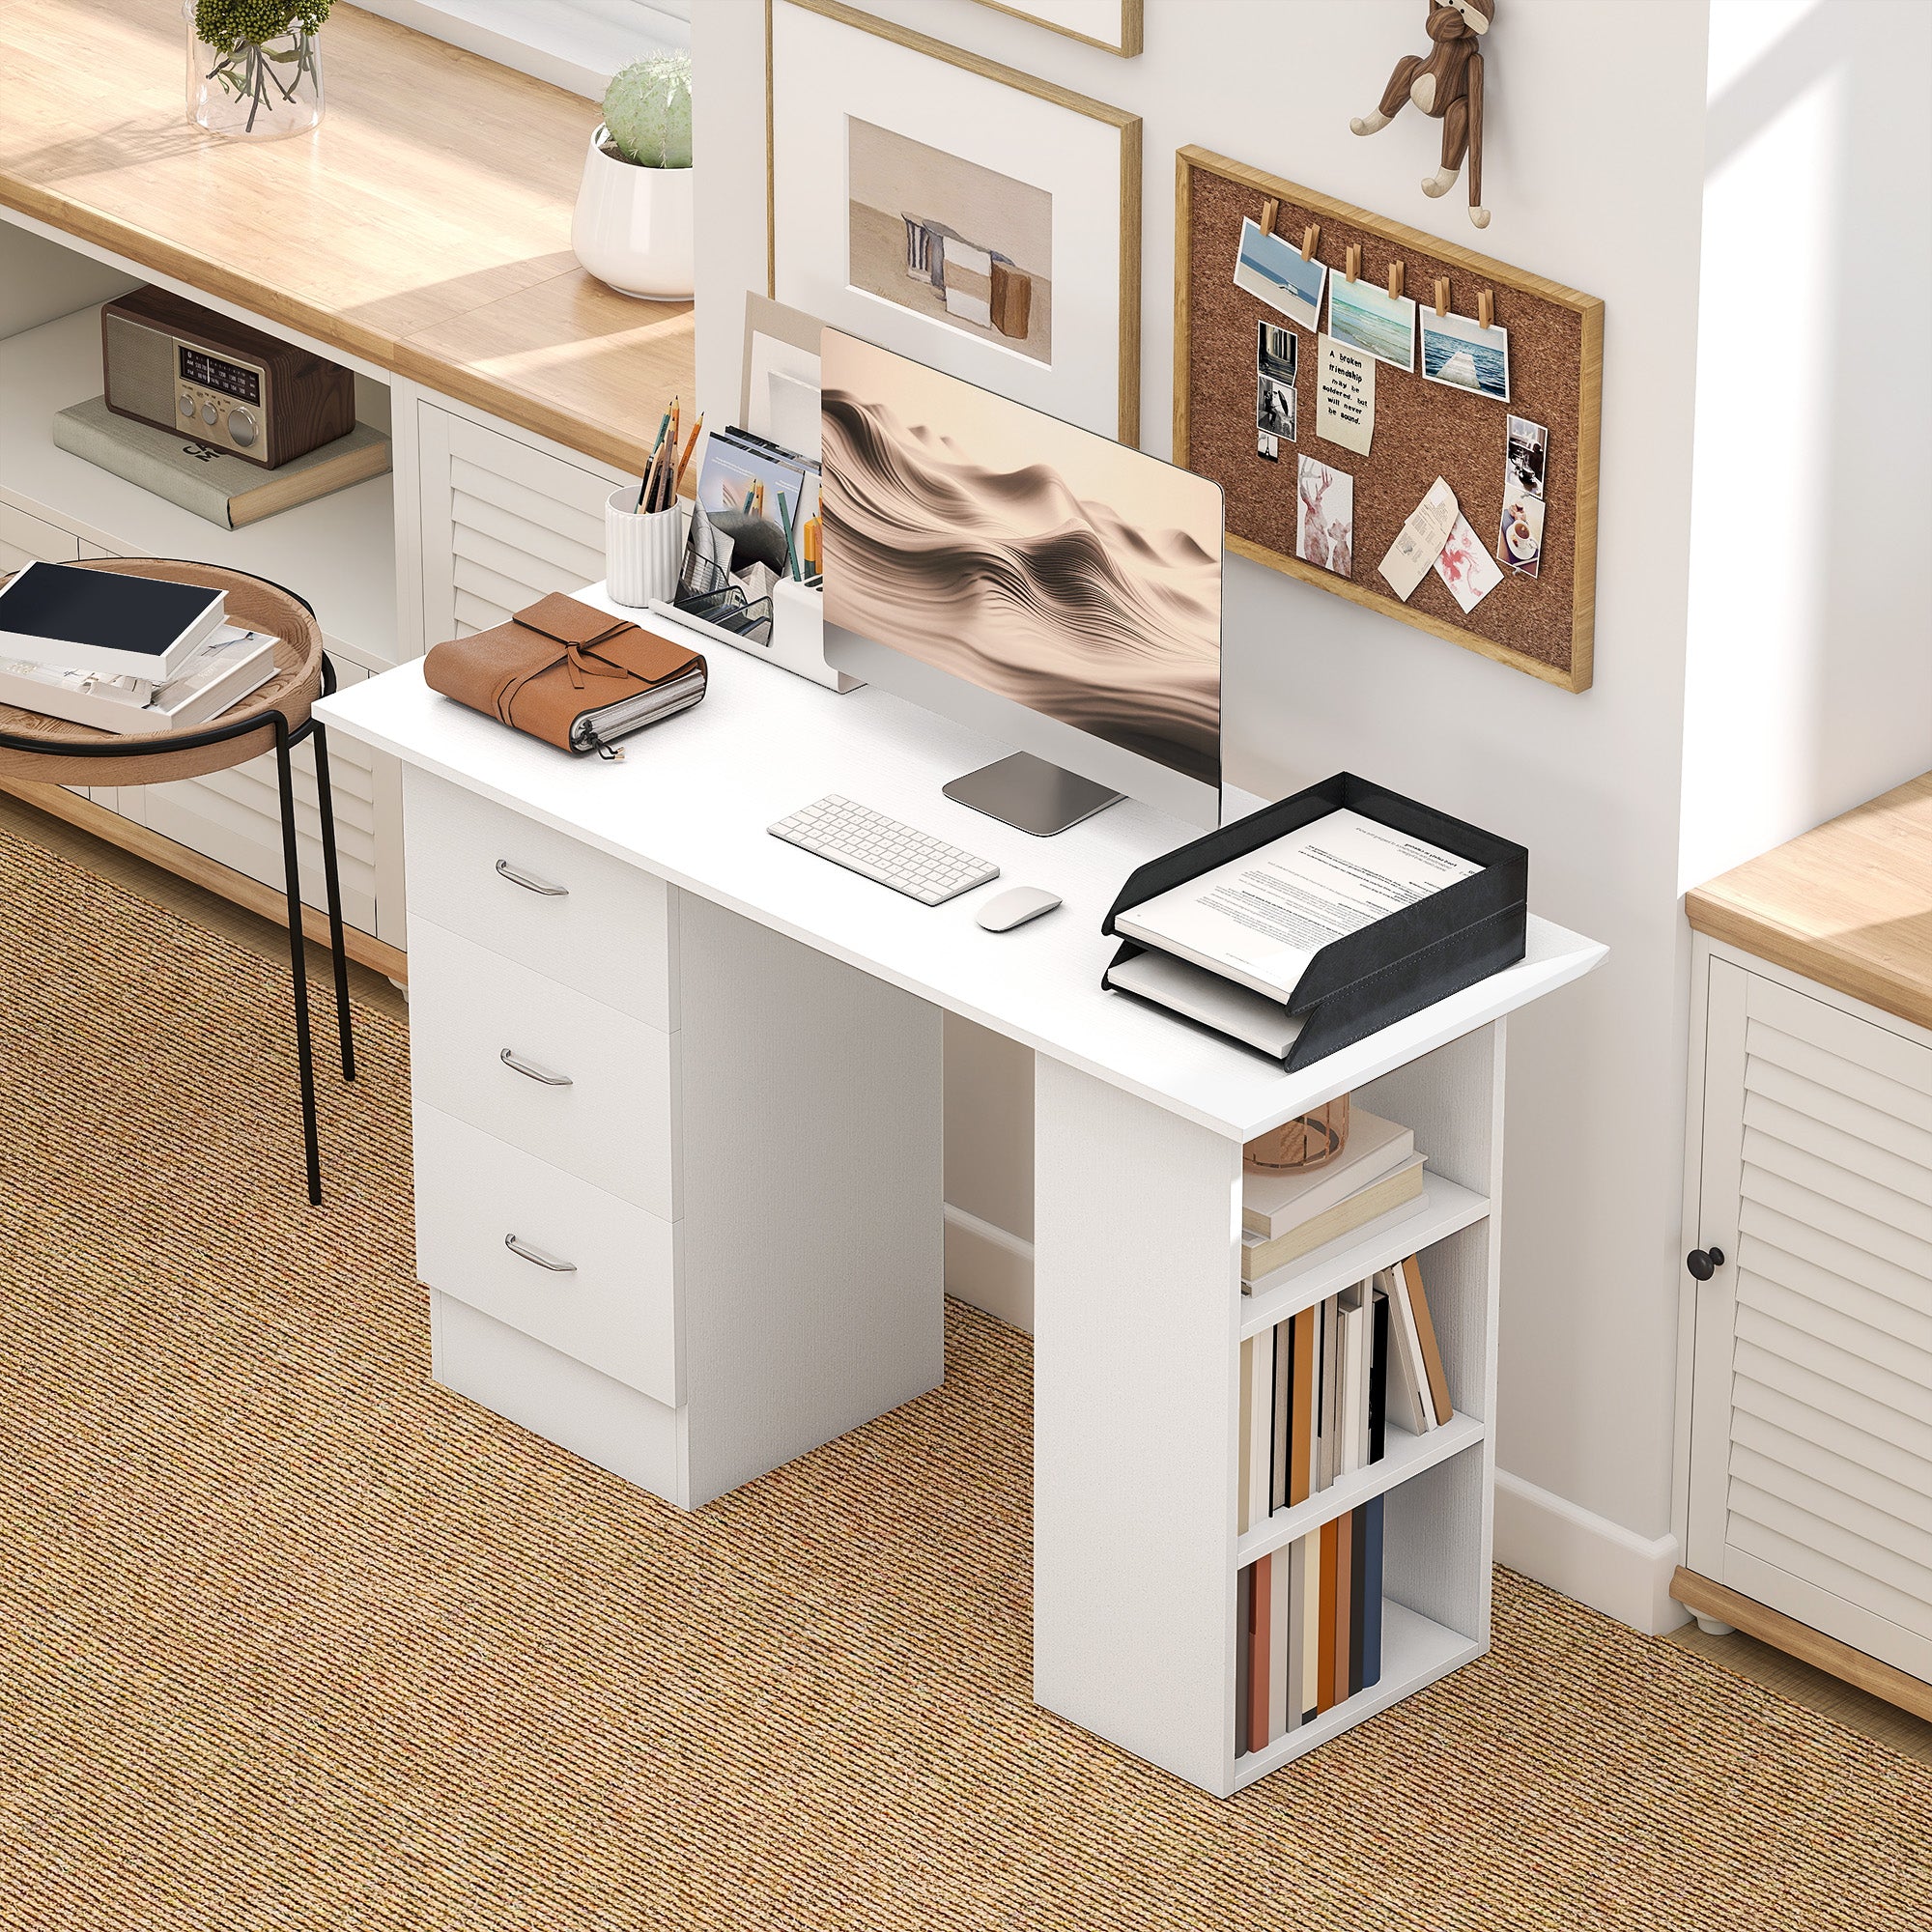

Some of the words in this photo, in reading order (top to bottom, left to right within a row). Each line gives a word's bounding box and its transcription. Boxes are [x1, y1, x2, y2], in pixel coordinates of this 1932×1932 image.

[1339, 353, 1362, 368] broken
[1328, 363, 1362, 384] friendship
[1331, 379, 1347, 389] may
[1327, 397, 1340, 407] will
[1344, 404, 1363, 414] never
[1328, 407, 1337, 415] be
[1341, 412, 1361, 425] sound.
